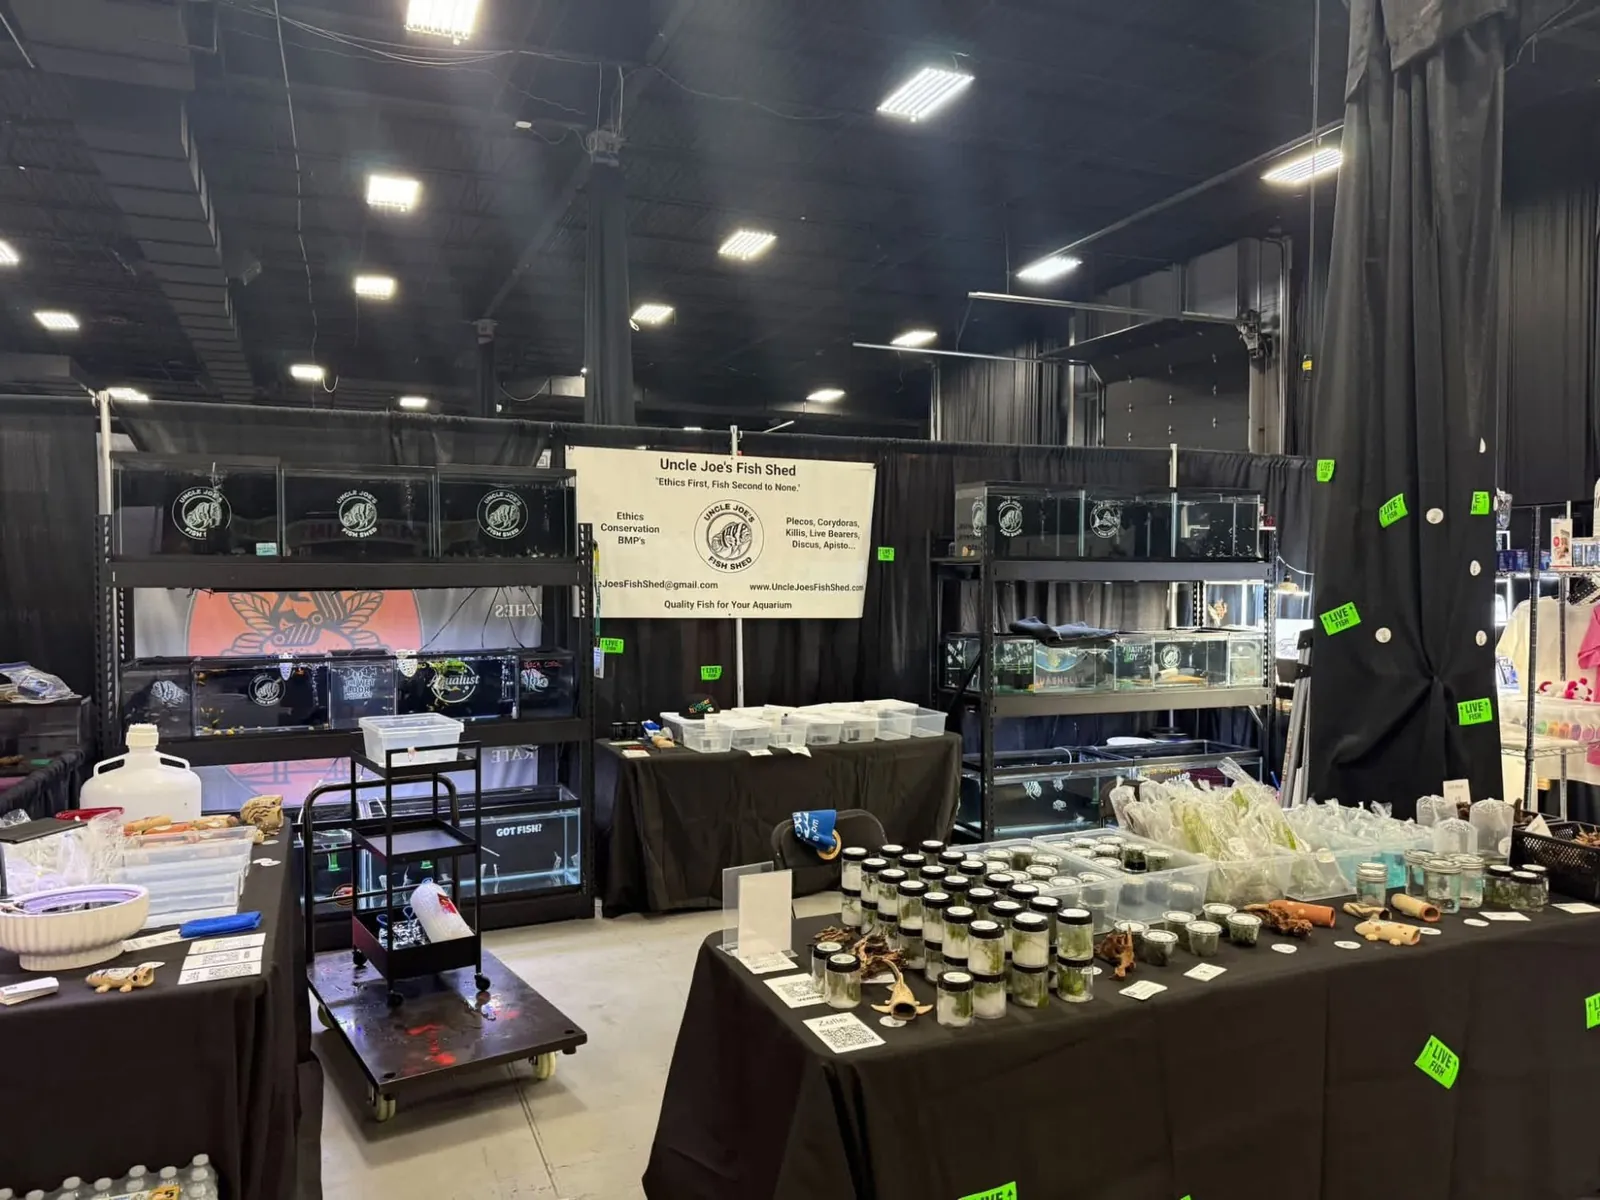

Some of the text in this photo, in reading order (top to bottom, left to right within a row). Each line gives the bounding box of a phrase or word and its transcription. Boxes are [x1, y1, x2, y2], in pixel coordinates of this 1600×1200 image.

[660, 458, 796, 477] Uncle Joe's Fish Shed
[687, 479, 710, 489] First,
[711, 480, 730, 489] Fish
[732, 481, 763, 491] Second
[764, 483, 773, 491] to
[1384, 499, 1398, 515] LIVE
[616, 511, 644, 521] Ethics
[704, 503, 755, 523] UNCLE JOE'S
[786, 517, 860, 528] Plecos, Corydoras,
[600, 523, 660, 534] Conservation
[785, 528, 860, 540] Killis, Live Bearers,
[617, 536, 646, 546] BMP's
[792, 540, 856, 550] Discus, Apisto...
[708, 555, 752, 570] FISH SHED
[749, 582, 864, 592] www.UncleJoesFishShed.com
[664, 600, 792, 610] Quality Fish for Your Aquarium
[1329, 607, 1348, 622] LIVE
[1466, 702, 1483, 713] LIVE
[496, 827, 516, 837] GOT
[1432, 1044, 1452, 1069] LIVE
[1429, 1060, 1446, 1076] FISH
